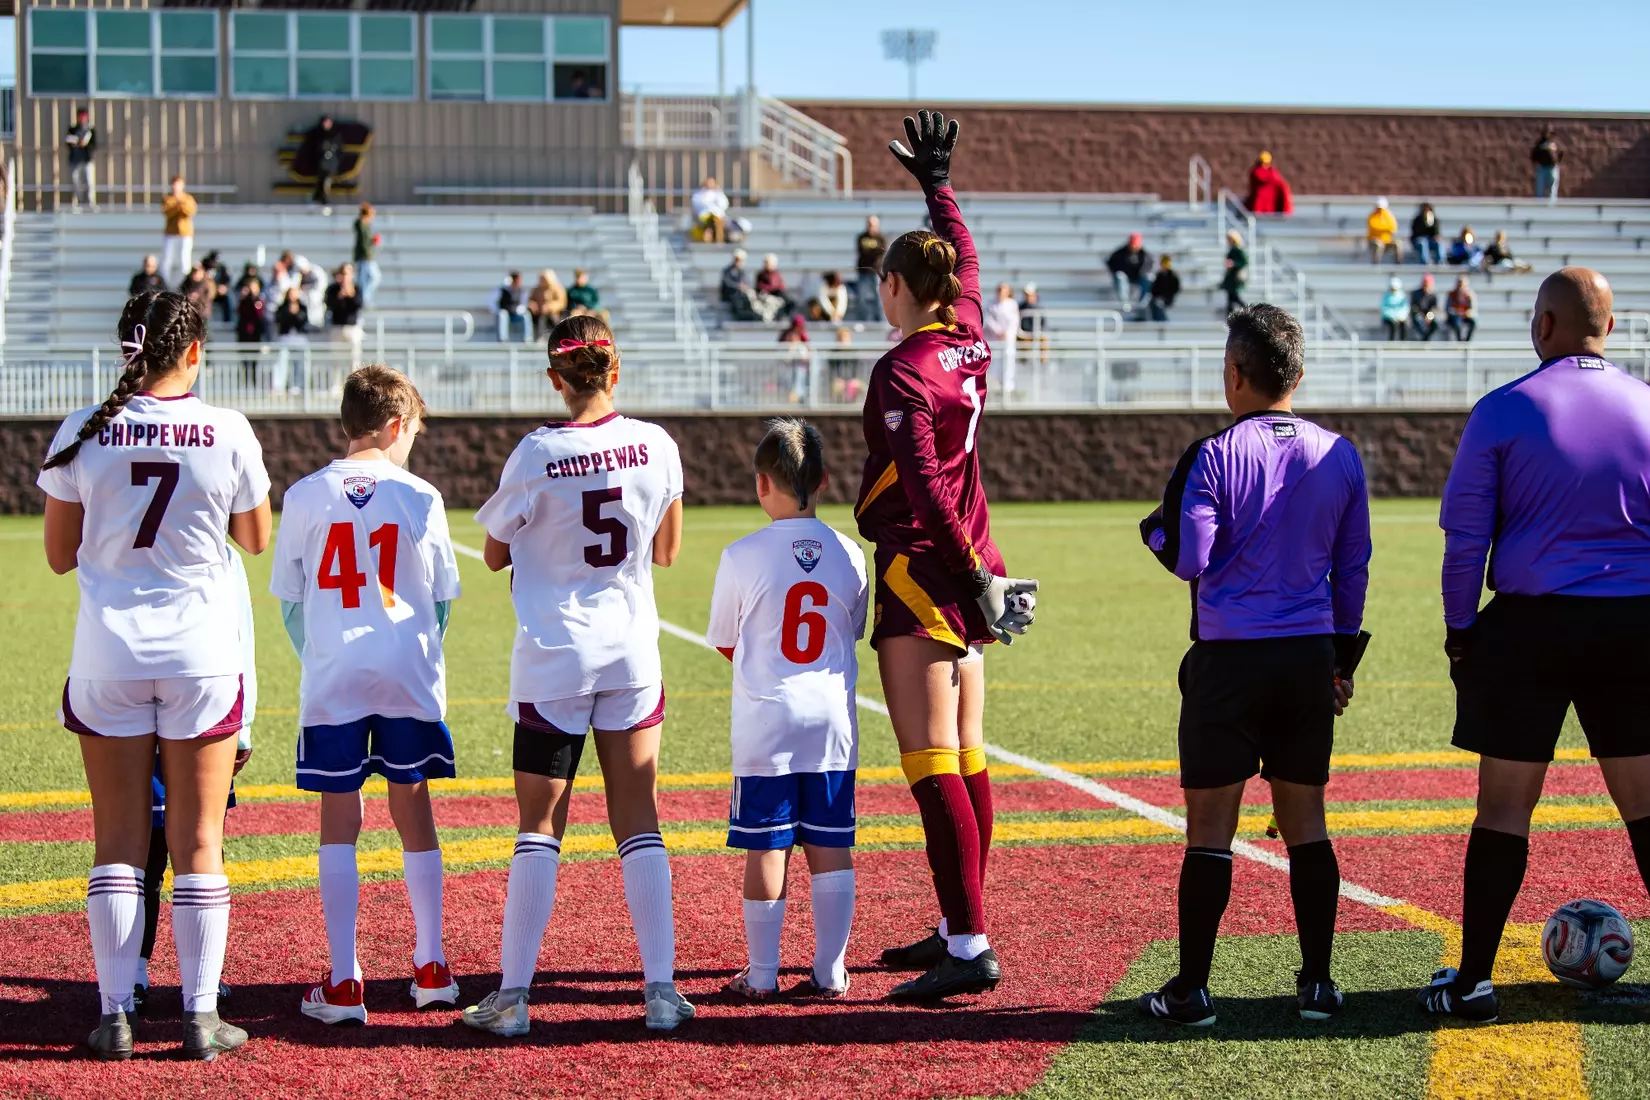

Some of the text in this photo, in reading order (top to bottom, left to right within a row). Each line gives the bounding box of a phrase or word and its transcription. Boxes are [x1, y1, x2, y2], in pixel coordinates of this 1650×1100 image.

[98, 423, 215, 447] CHIPPEWAS
[961, 376, 981, 454] 1
[545, 443, 649, 479] CHIPPEWAS
[131, 462, 180, 549] 7
[581, 486, 628, 568] 5
[317, 522, 399, 609] 41
[780, 580, 829, 665] 6
